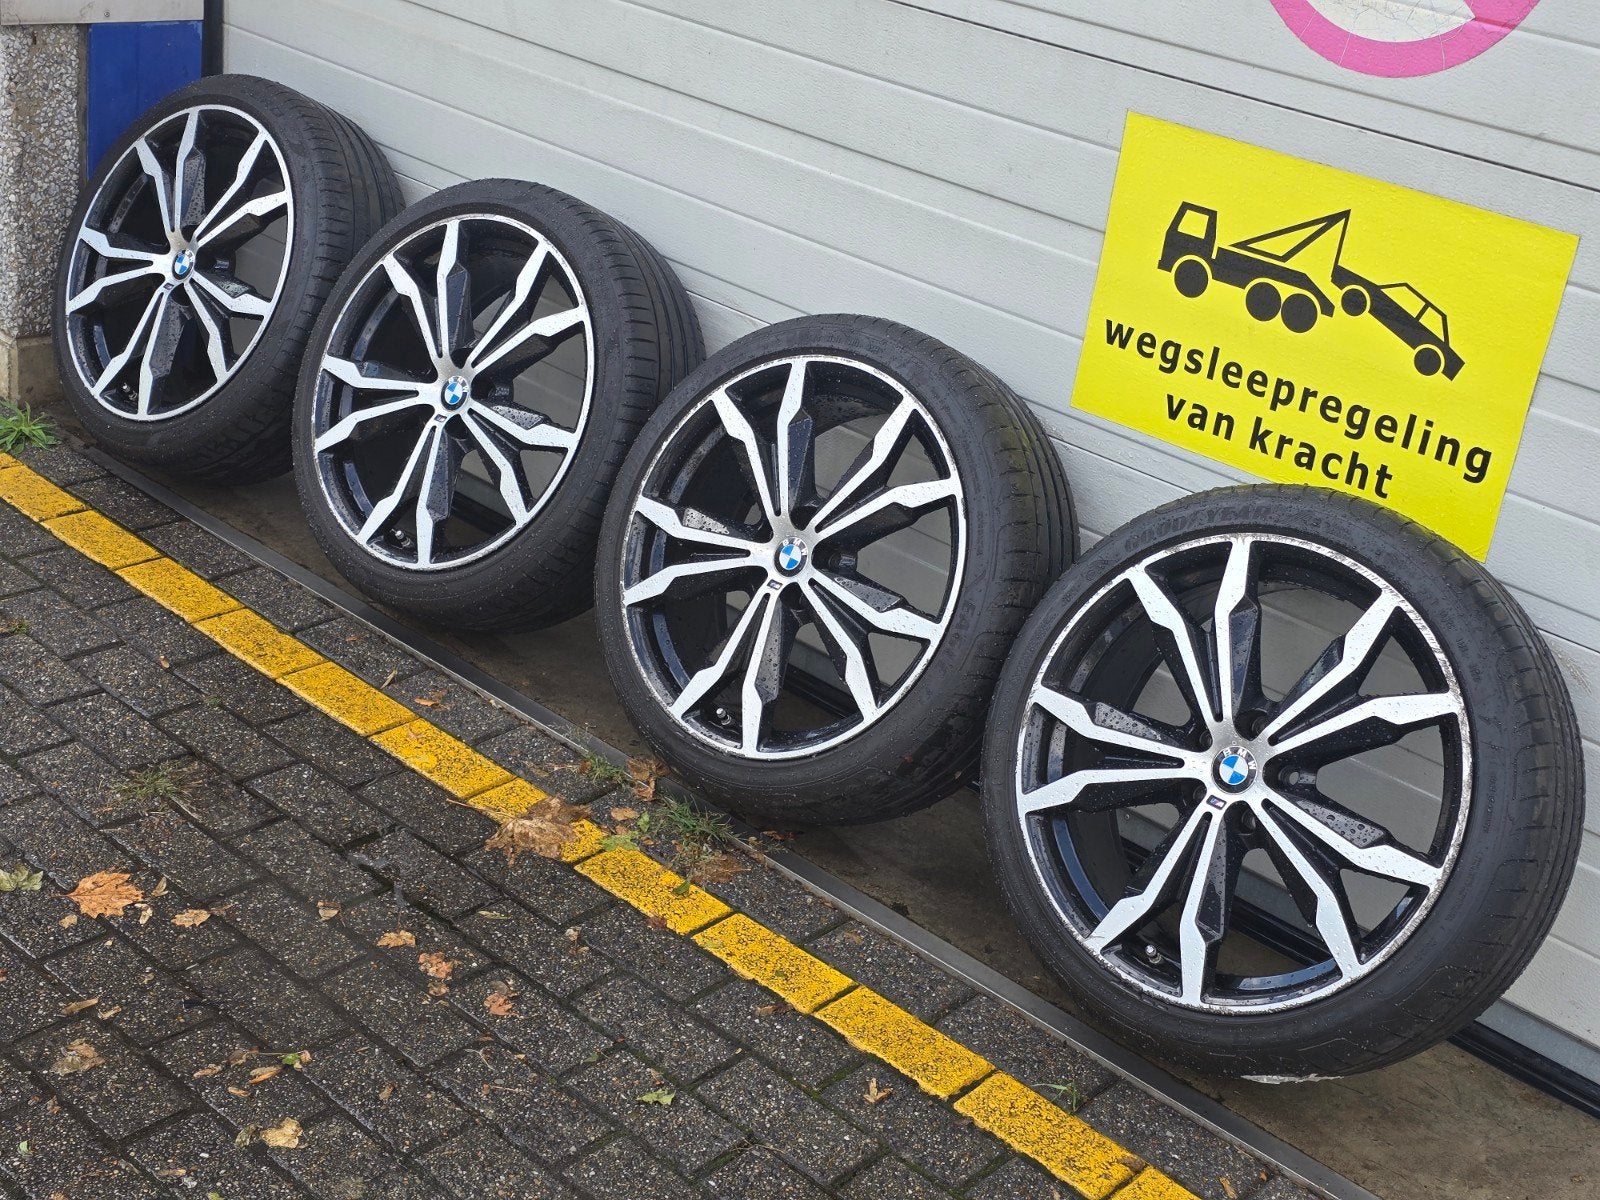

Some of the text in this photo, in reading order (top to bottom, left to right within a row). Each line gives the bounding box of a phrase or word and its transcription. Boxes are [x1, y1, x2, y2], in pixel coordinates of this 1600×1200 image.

[1106, 318, 1492, 484] wegsleepregeling
[1166, 393, 1393, 499] van kracht
